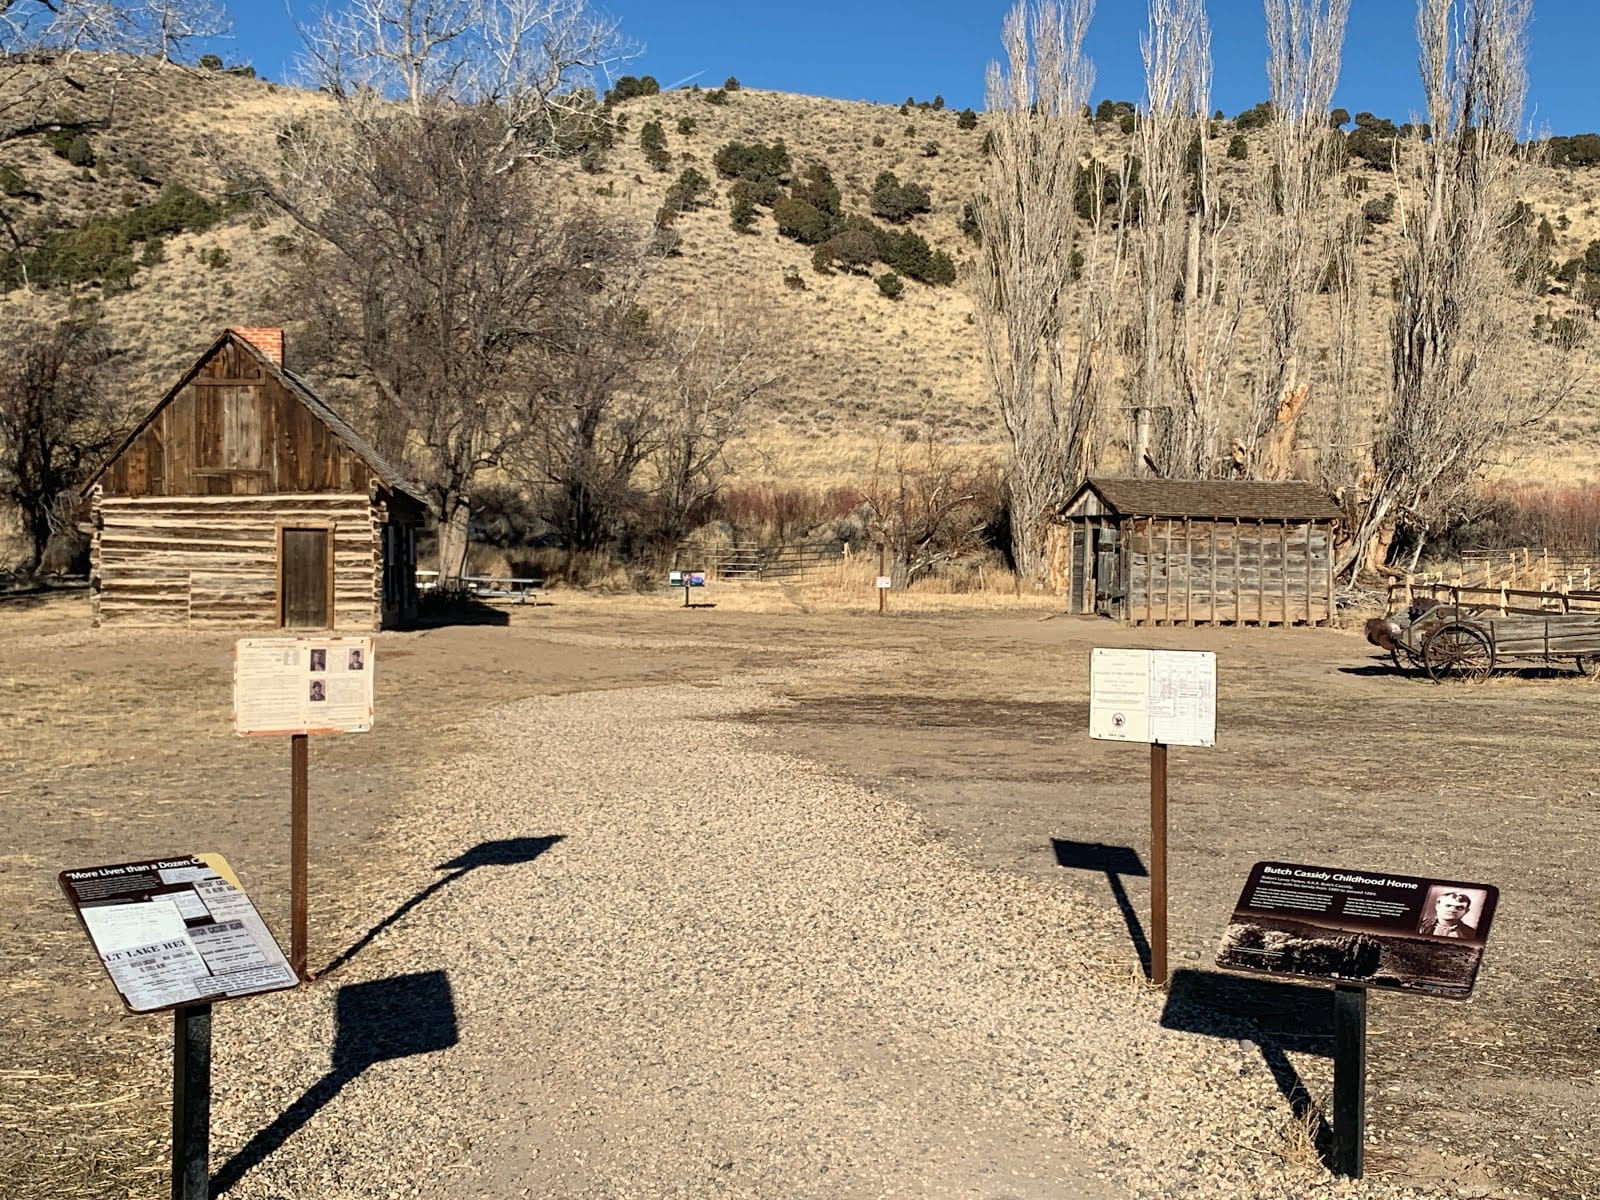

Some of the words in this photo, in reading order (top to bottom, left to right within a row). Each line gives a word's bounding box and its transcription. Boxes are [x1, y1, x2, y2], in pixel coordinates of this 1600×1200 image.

[99, 867, 125, 877] Lives
[126, 864, 150, 873] than
[158, 860, 191, 869] Dozen
[1264, 865, 1293, 876] Butch
[1294, 869, 1331, 881] Cassidy
[1332, 873, 1386, 886] Childhood
[1386, 879, 1419, 890] Home
[126, 945, 160, 958] LAKE
